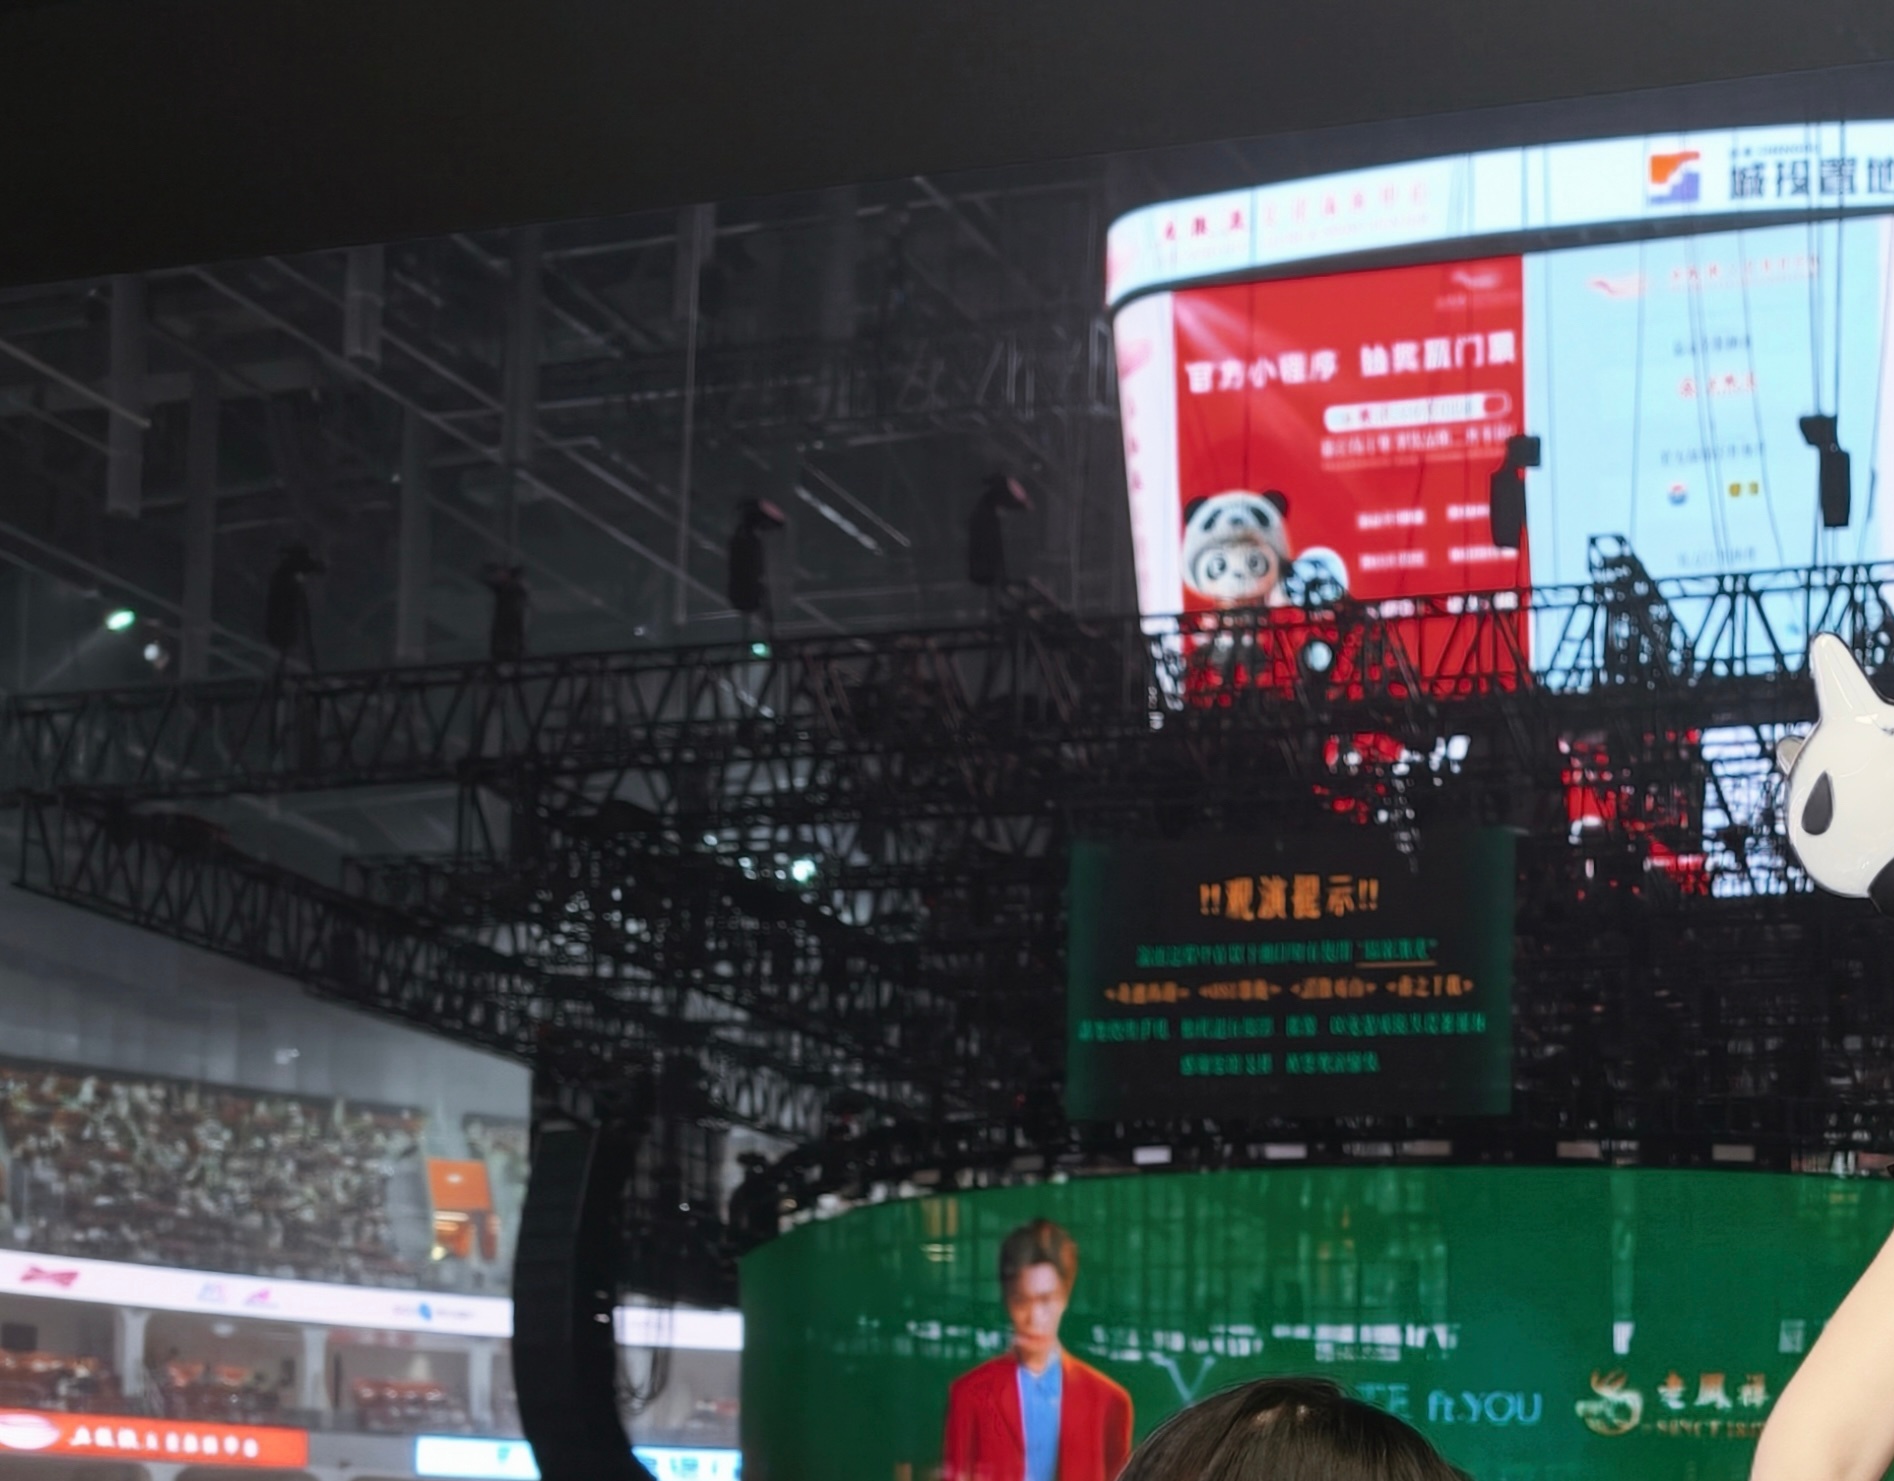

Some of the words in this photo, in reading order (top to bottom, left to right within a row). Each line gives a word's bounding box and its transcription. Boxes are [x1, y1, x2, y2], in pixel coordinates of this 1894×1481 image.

[1185, 349, 1339, 395] 官方小程序
